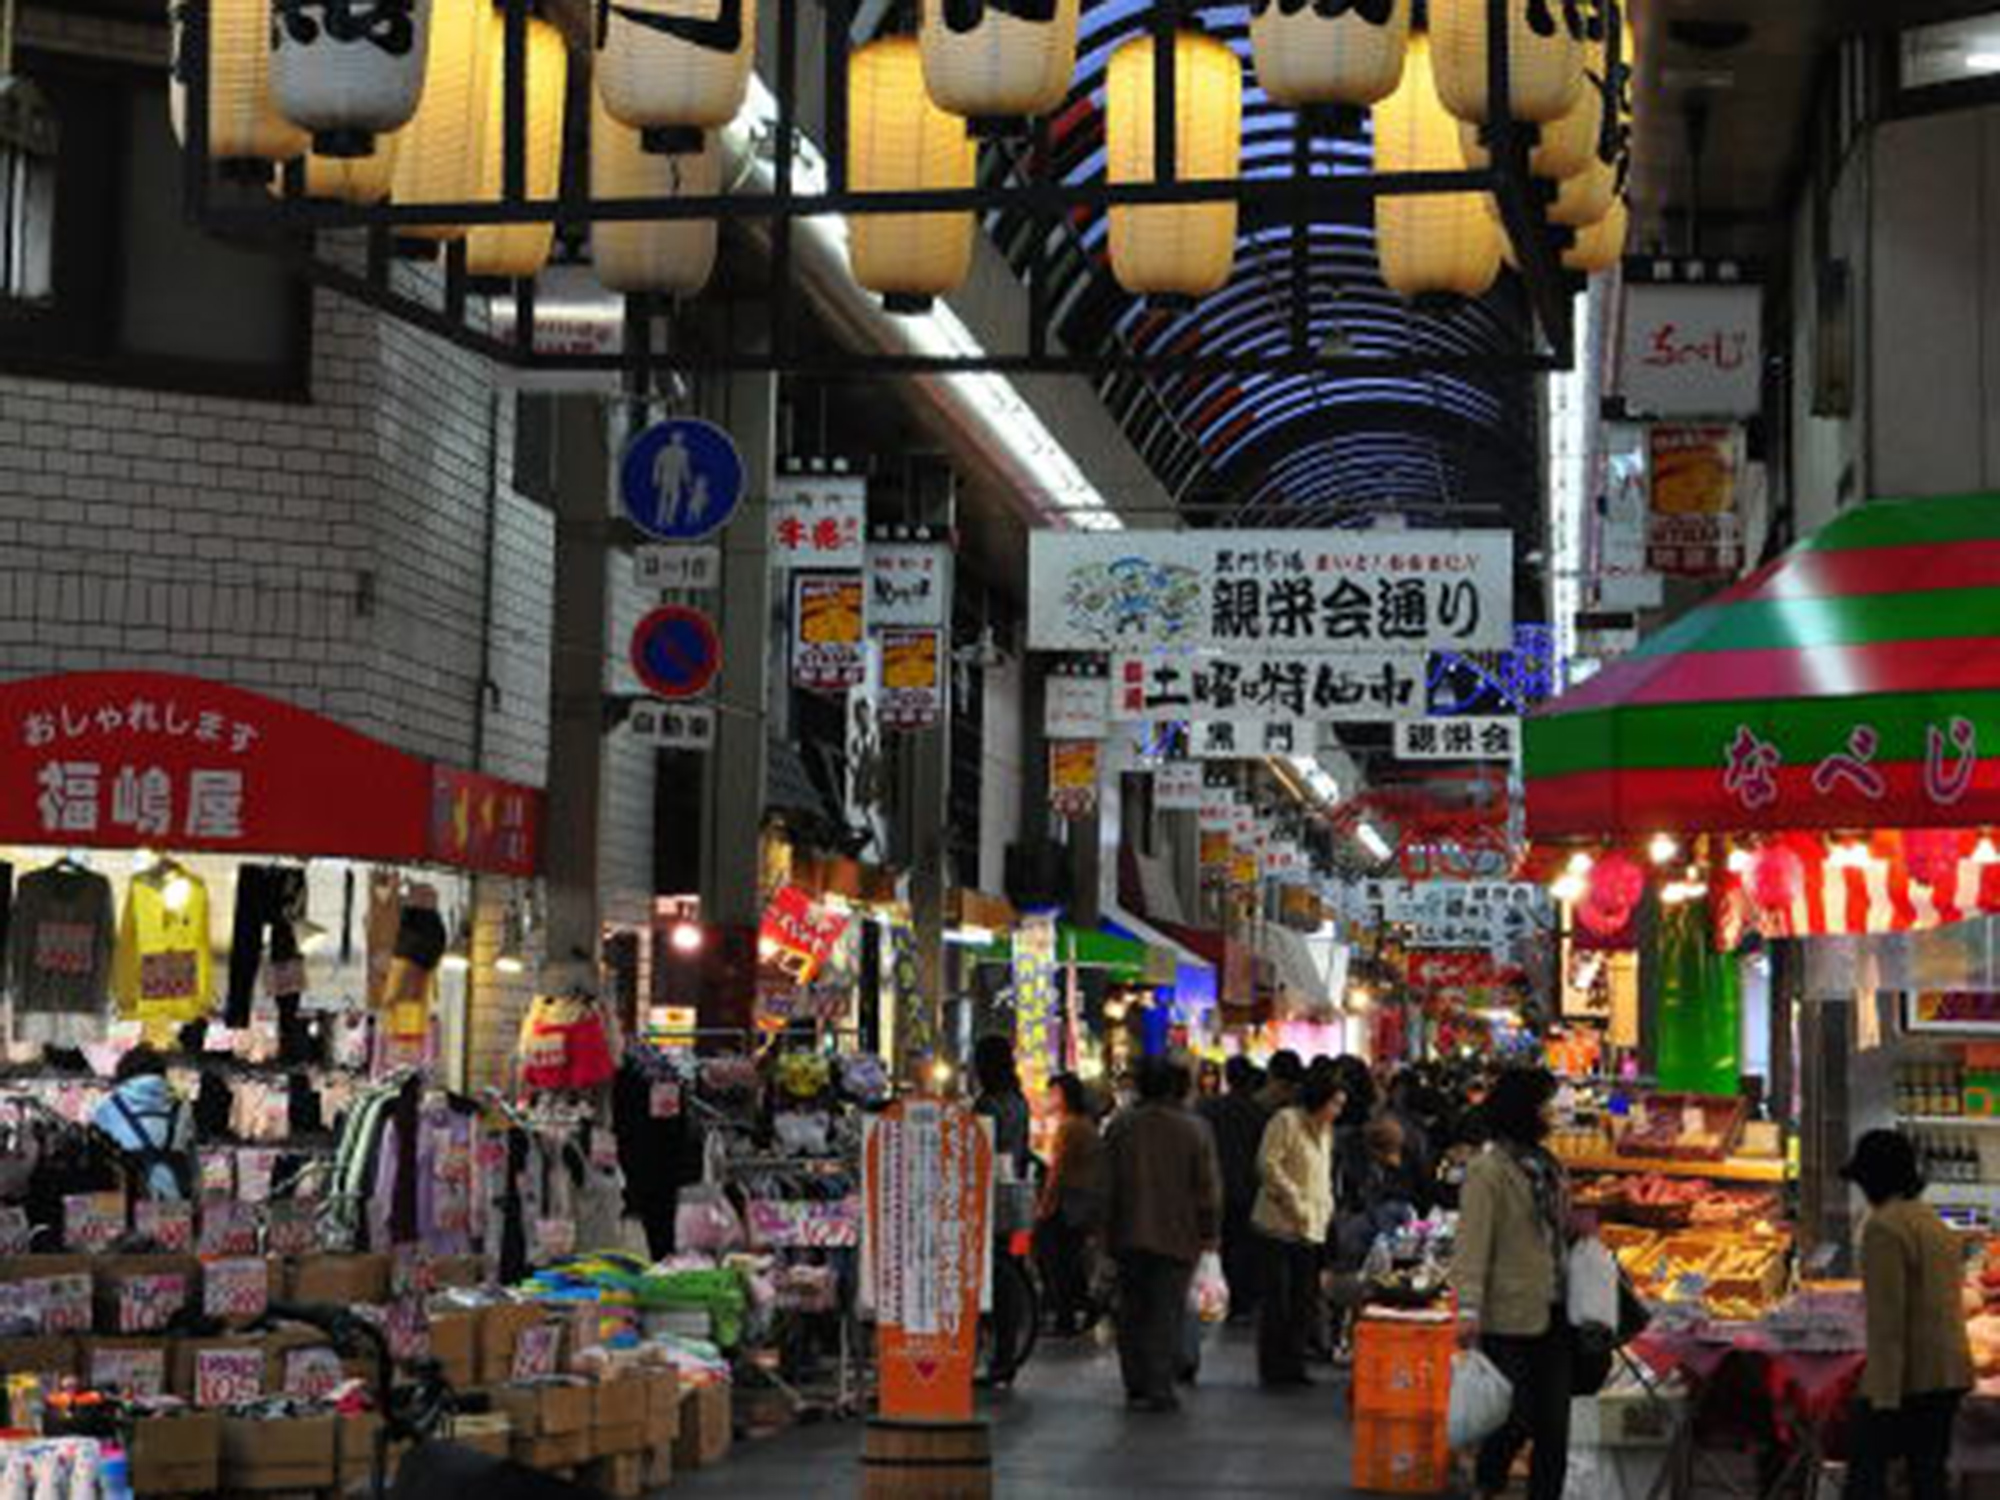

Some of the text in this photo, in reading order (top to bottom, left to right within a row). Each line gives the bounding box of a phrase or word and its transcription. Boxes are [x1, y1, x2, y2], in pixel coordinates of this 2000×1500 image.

[1211, 577, 1480, 639] 親栄会通り
[23, 699, 260, 752] おしゃれします
[1723, 715, 1977, 809] なべじ
[36, 759, 244, 839] 福嶋屋
